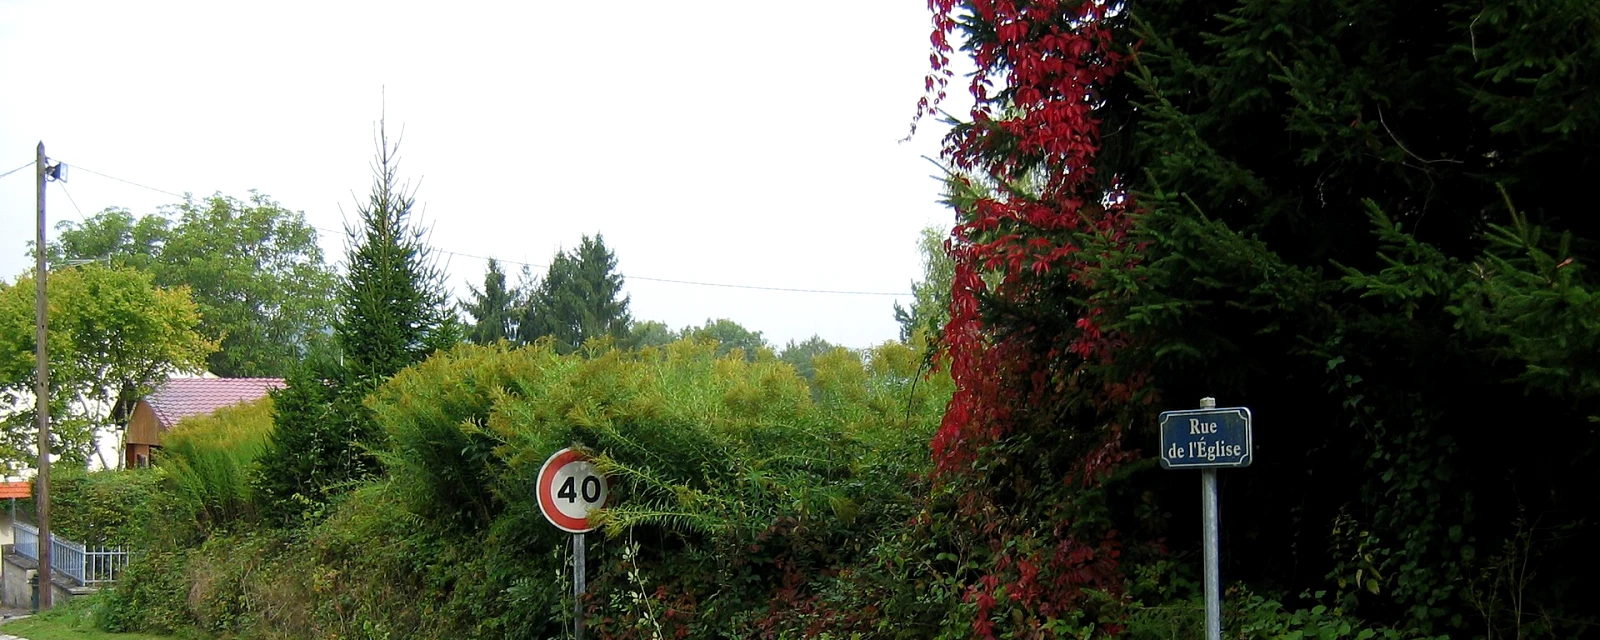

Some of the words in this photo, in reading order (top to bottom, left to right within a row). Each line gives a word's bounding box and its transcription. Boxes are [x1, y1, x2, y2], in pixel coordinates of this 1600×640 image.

[1189, 418, 1217, 434] Rue
[1168, 442, 1185, 459] de
[1189, 436, 1241, 461] l'Église
[557, 475, 601, 503] 40
